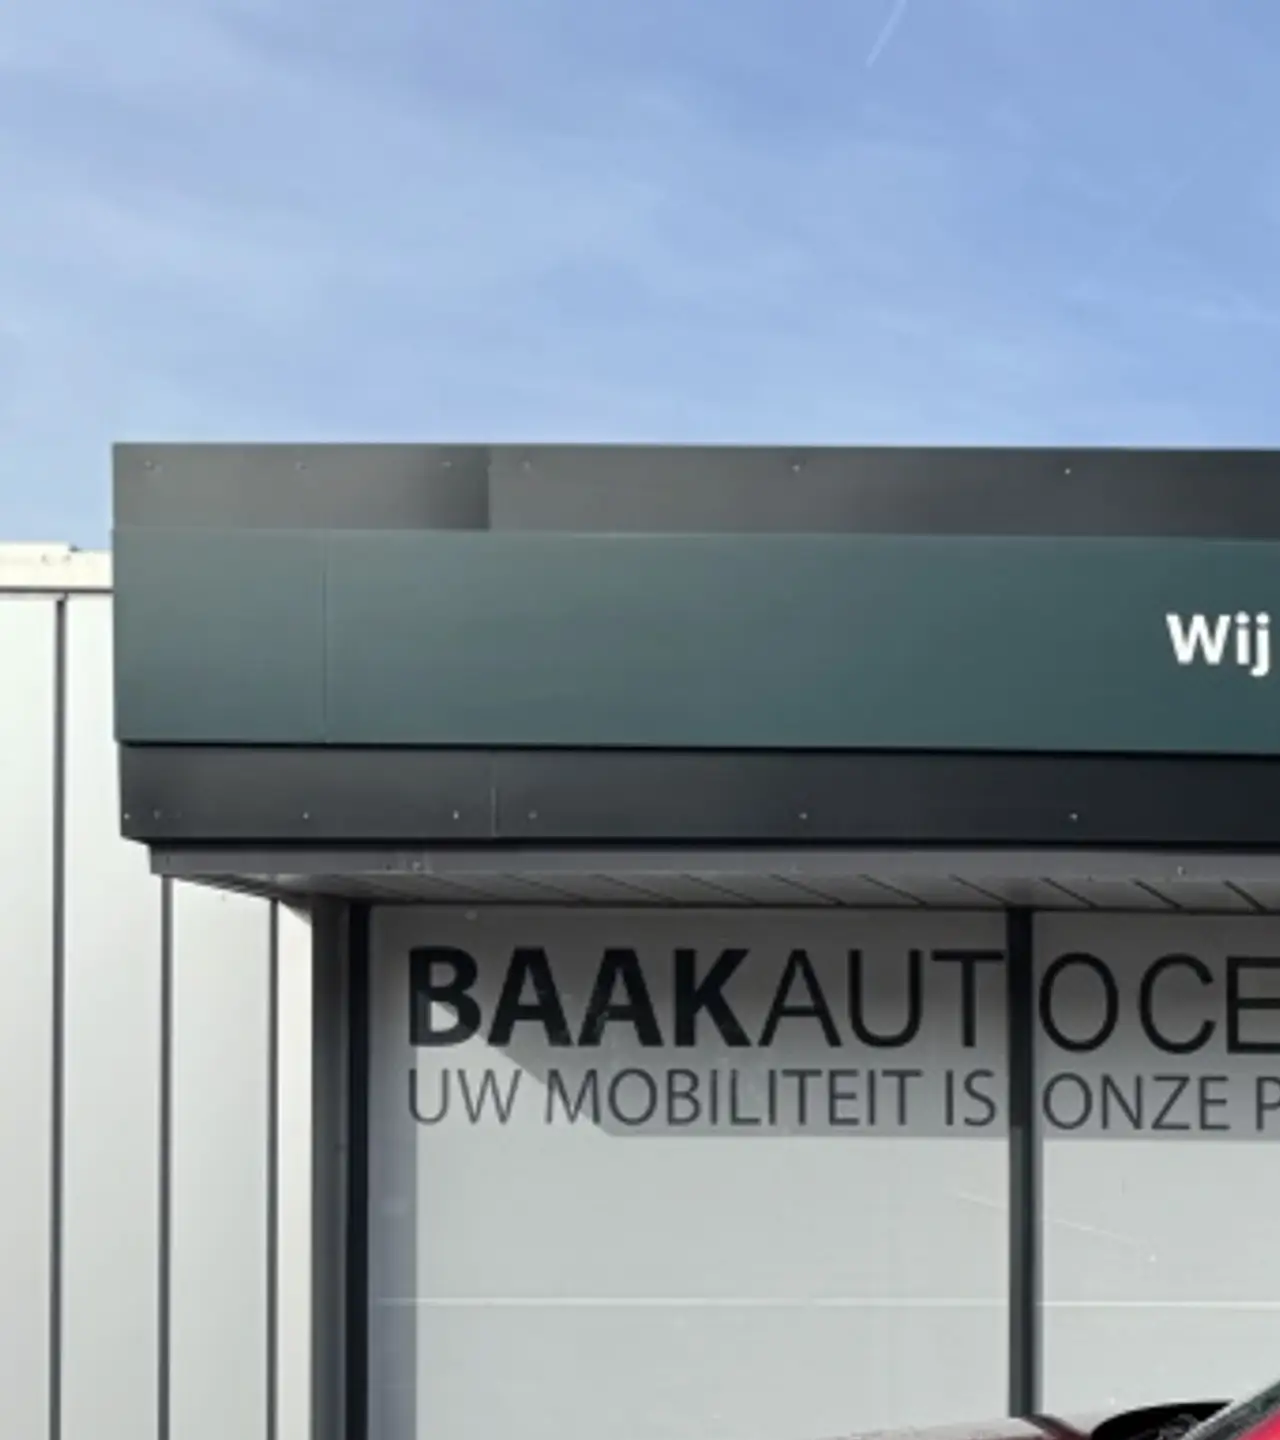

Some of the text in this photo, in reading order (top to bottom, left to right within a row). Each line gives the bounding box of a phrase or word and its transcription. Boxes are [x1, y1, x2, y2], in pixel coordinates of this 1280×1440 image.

[1165, 610, 1272, 678] Wij
[407, 1067, 523, 1126] UW
[544, 1067, 923, 1128] MOBILITEIT
[943, 1068, 998, 1128] IS
[1041, 1072, 1229, 1132] ONZE
